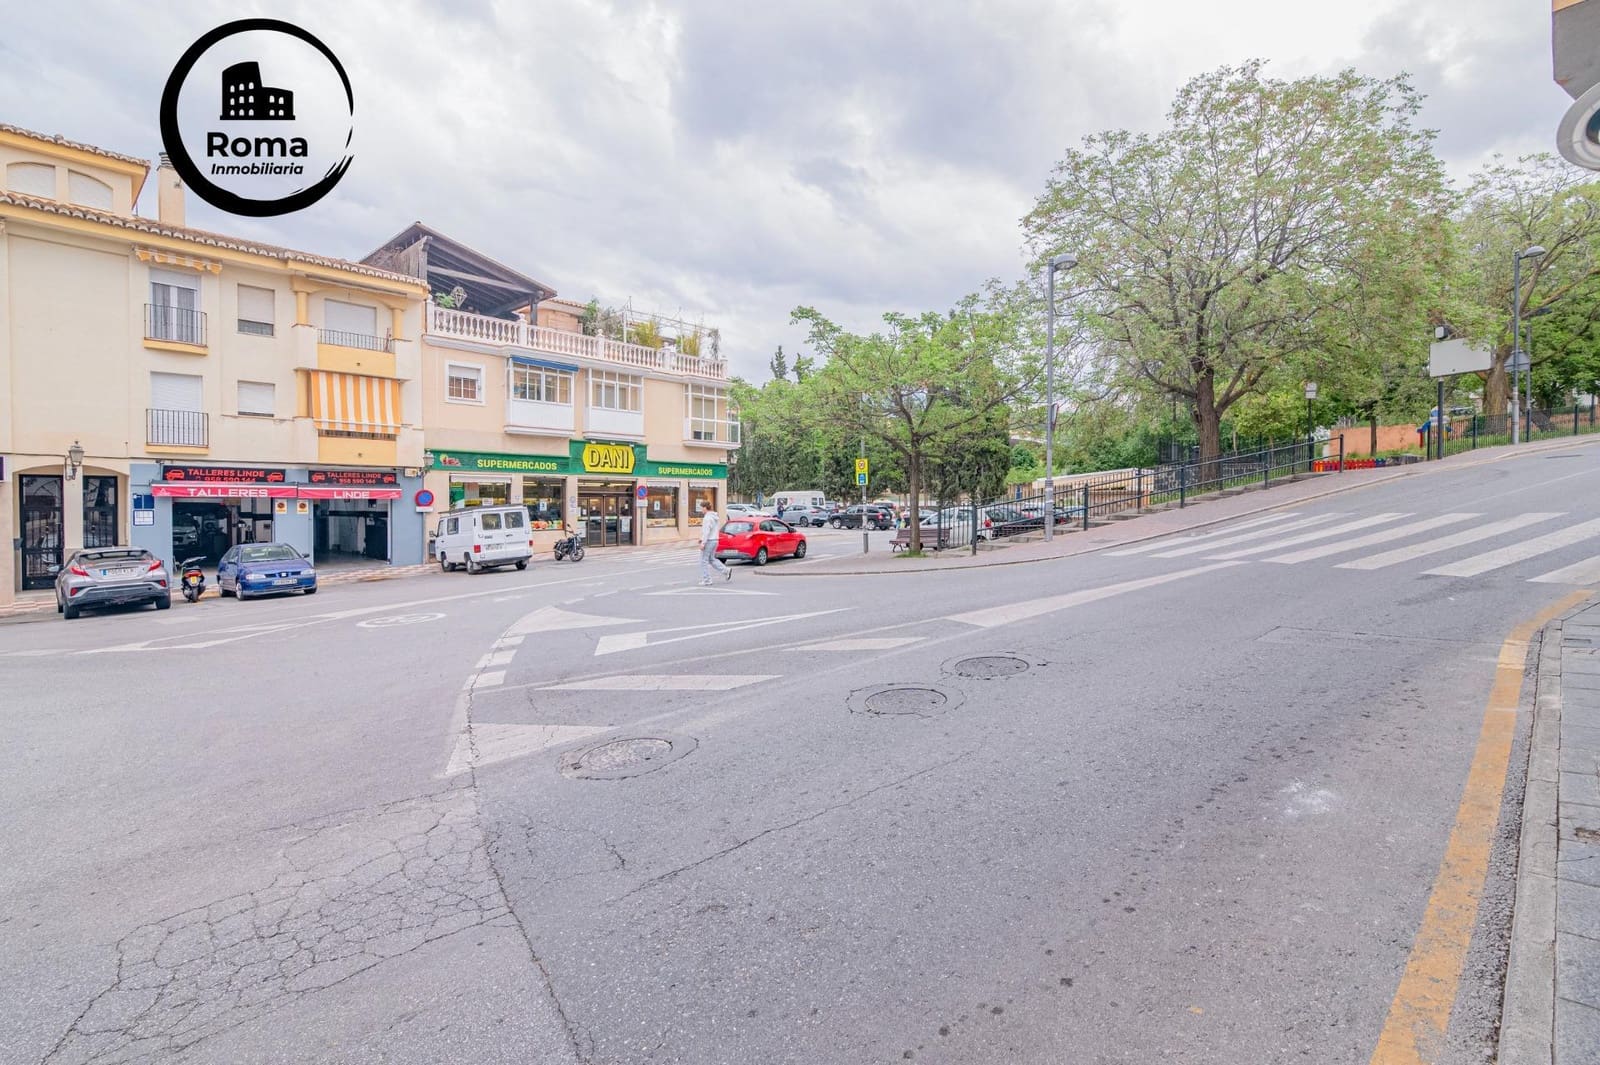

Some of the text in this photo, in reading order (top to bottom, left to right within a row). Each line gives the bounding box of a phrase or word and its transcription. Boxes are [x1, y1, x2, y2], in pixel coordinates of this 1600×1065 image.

[588, 446, 630, 469] DANI
[477, 459, 558, 471] SUPERMERCADOS
[187, 468, 265, 478] TALLERES LINDE
[327, 471, 360, 479] TALLERES
[658, 466, 713, 476] SUPERMERCADOS
[187, 487, 269, 498] TALLERES
[333, 490, 371, 500] LINDE
